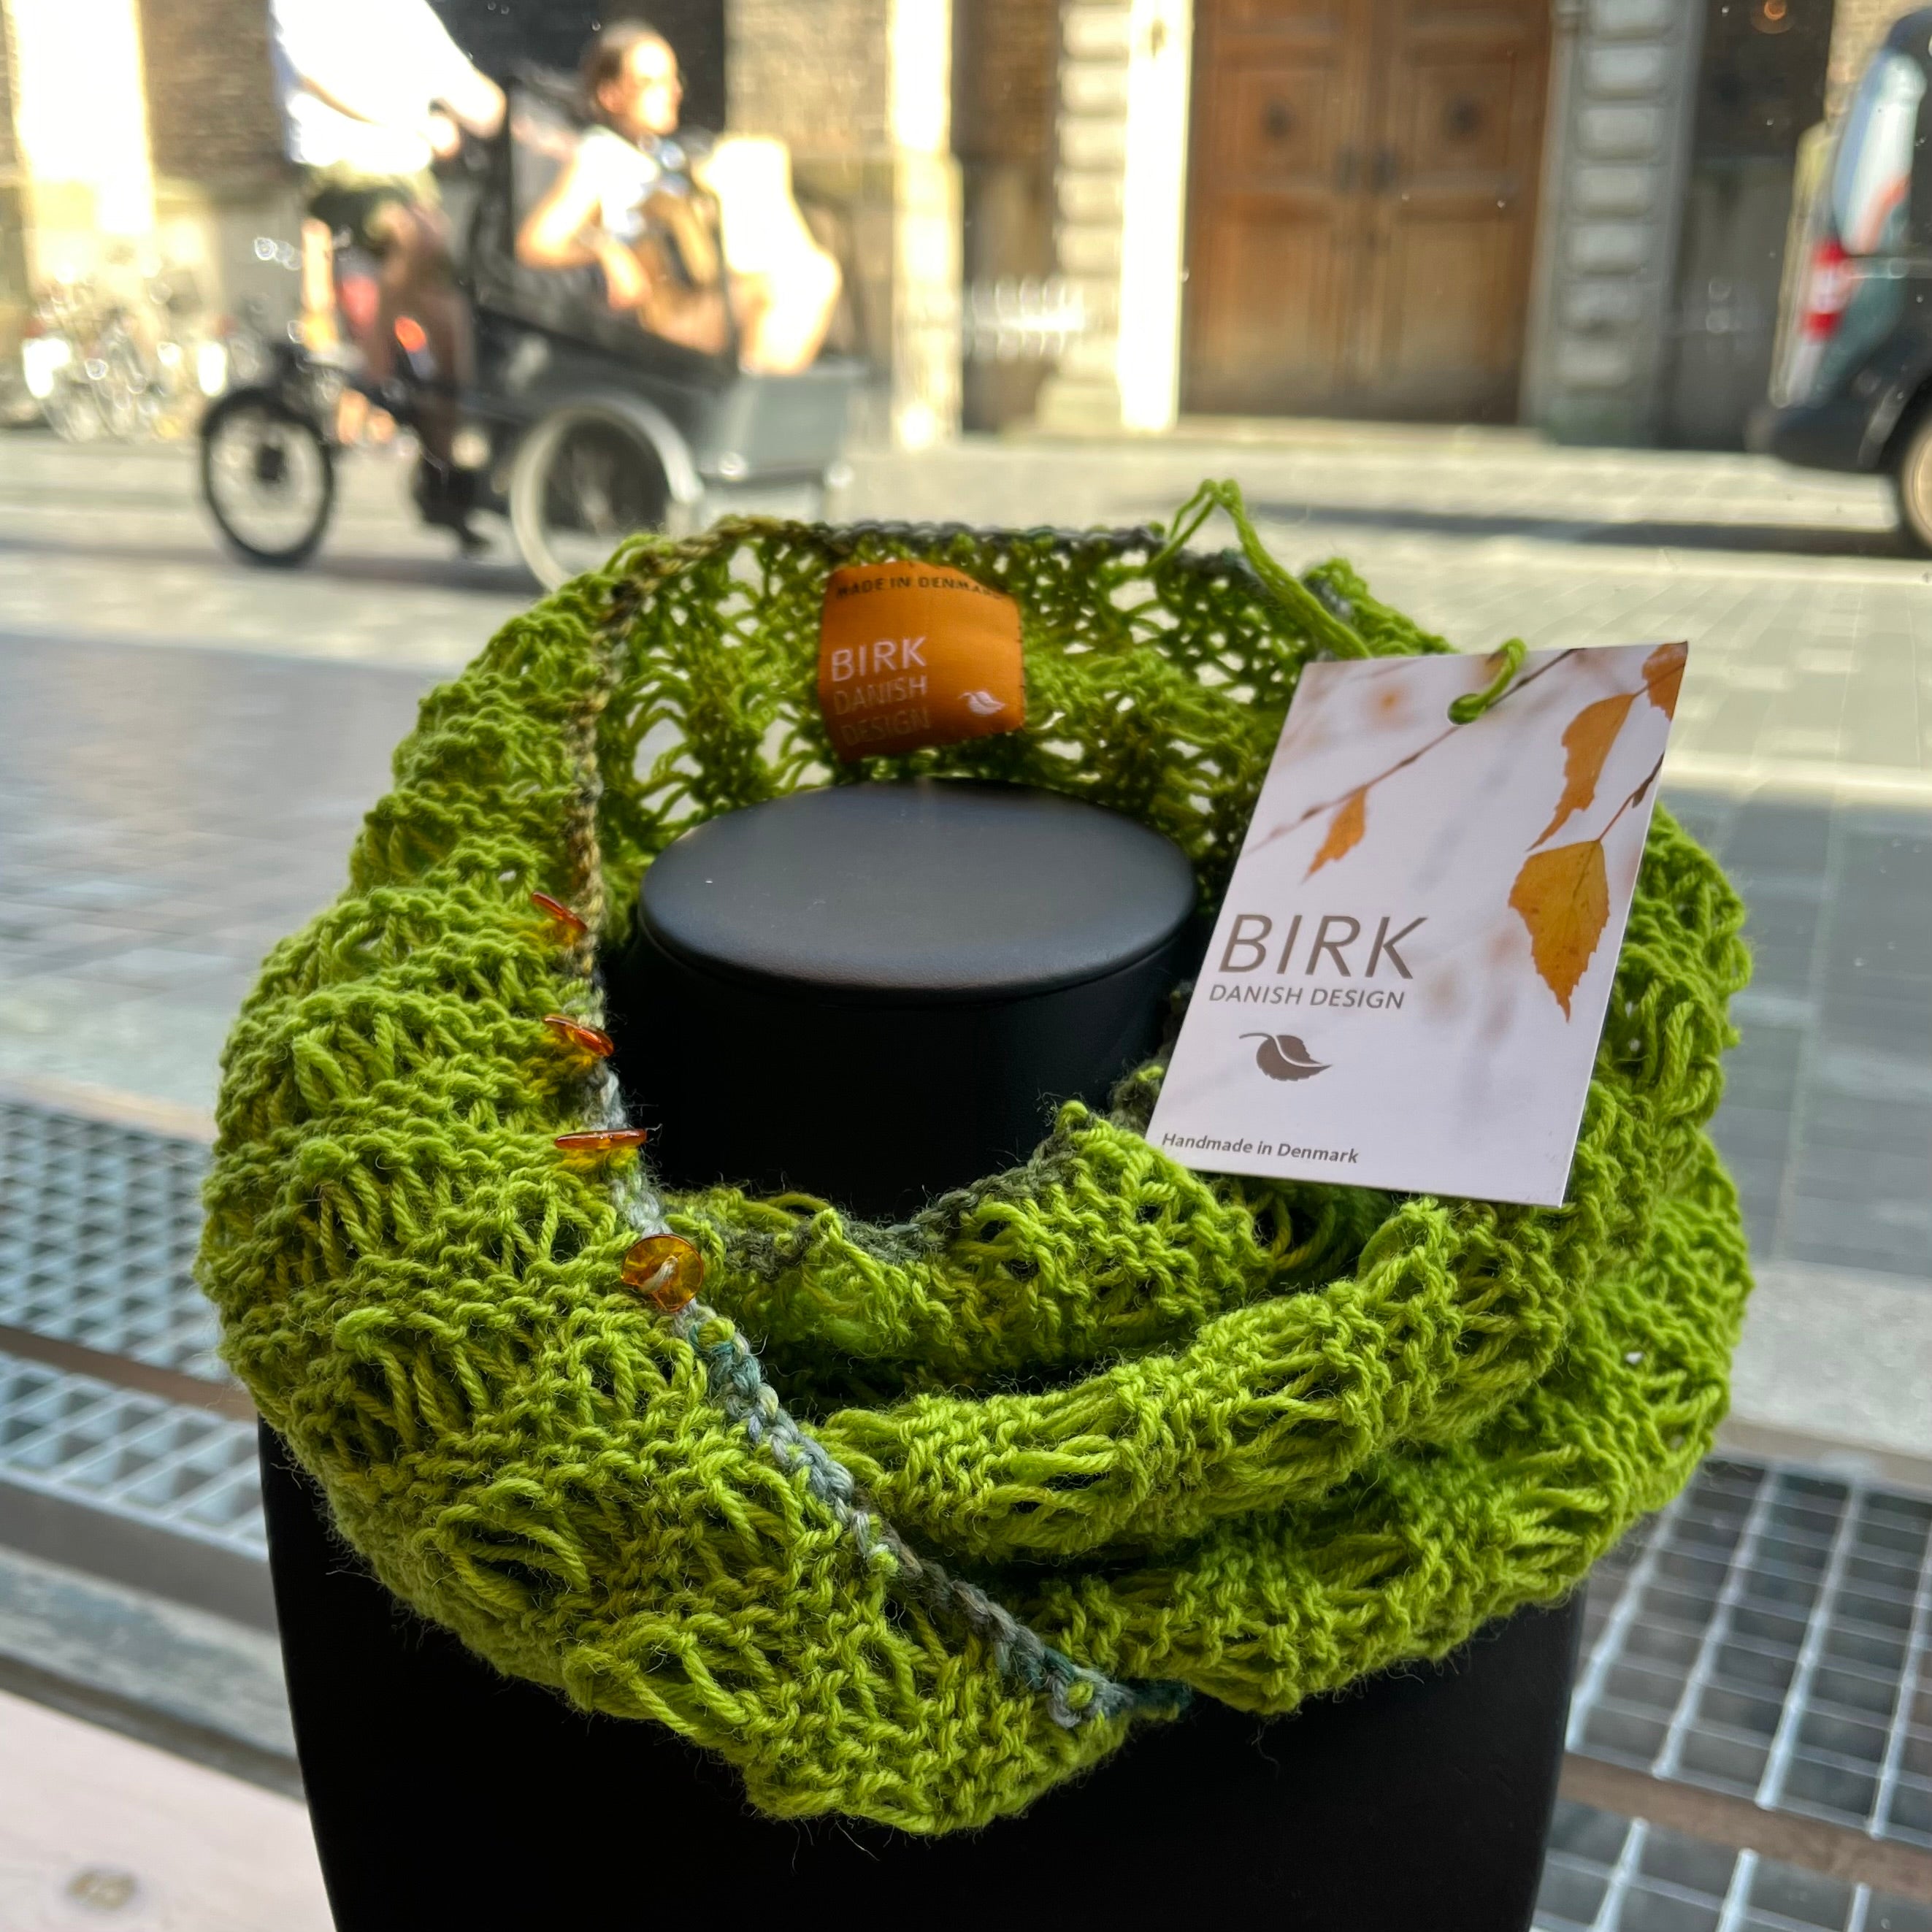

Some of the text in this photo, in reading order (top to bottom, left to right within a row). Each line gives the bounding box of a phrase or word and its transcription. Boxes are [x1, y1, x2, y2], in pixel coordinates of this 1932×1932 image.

[837, 577, 885, 598] MADE
[889, 577, 910, 589] IN
[831, 636, 927, 682] BIRK
[833, 675, 927, 716] DANISH
[1218, 913, 1429, 980] BIRK
[1208, 984, 1406, 1010] DANISH DESIGN
[1161, 1132, 1360, 1164] Handmade in Denmark
